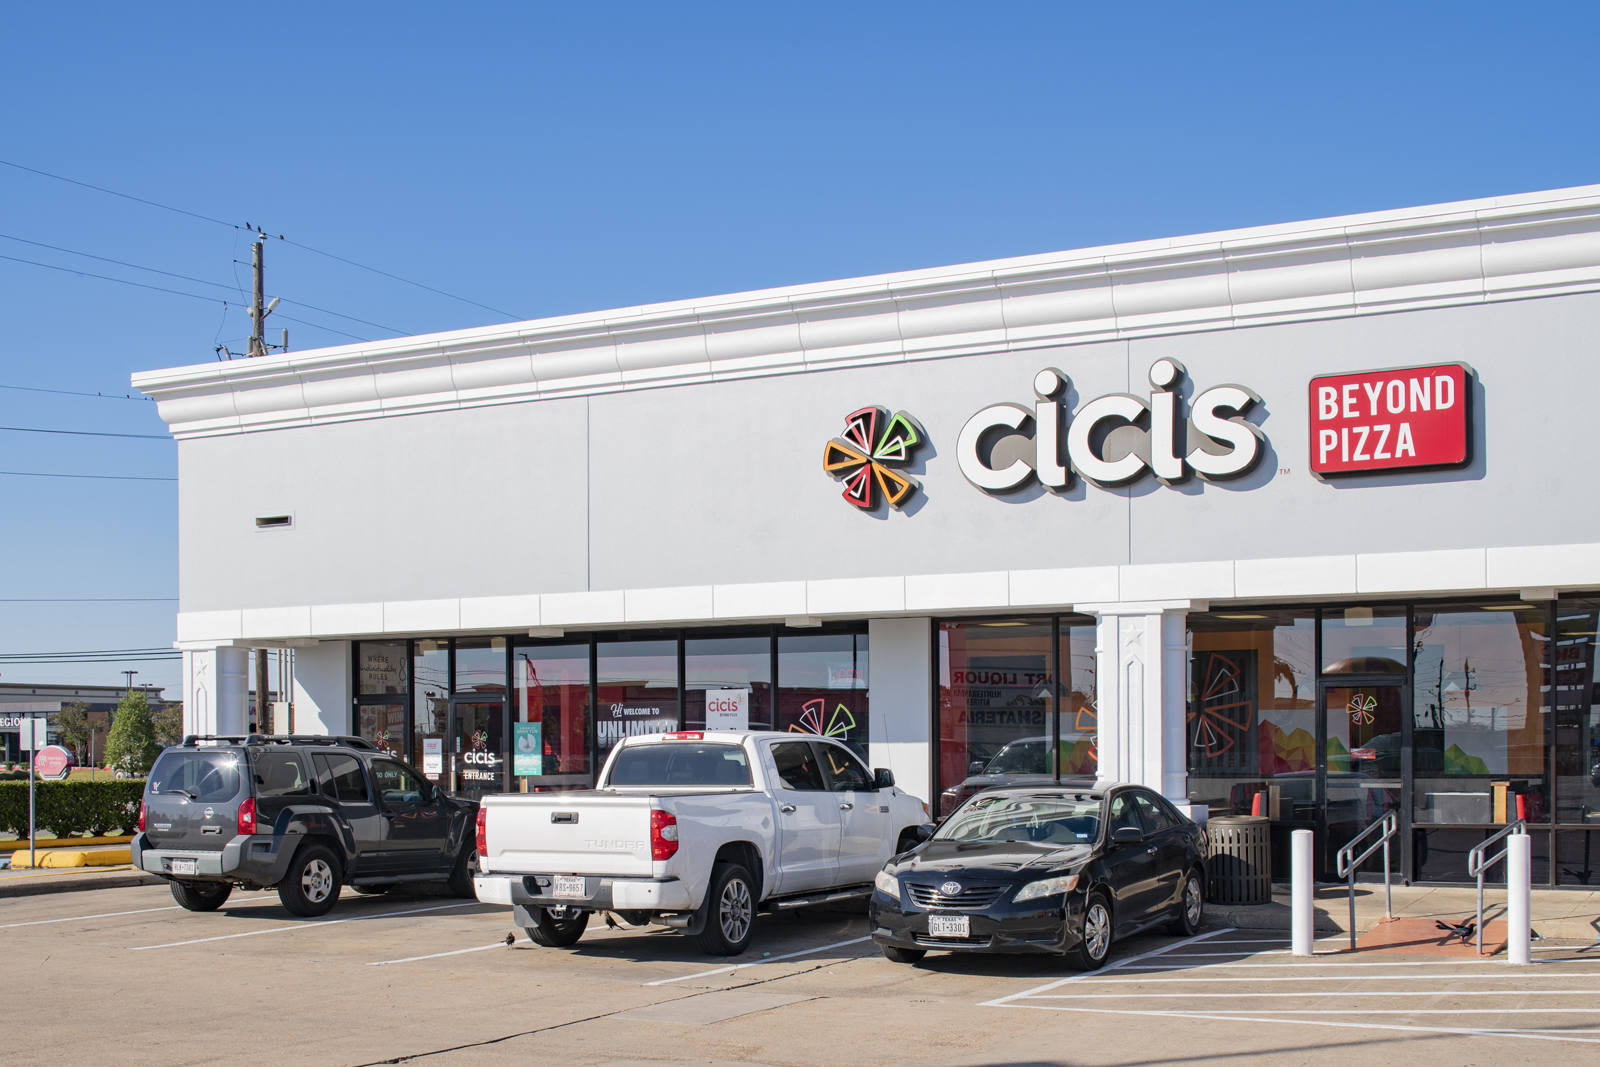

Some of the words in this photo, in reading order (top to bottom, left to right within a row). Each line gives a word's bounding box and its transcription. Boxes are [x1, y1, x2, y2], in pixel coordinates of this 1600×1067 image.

[1317, 375, 1456, 421] BEYOND
[957, 357, 1261, 490] cicis
[1318, 422, 1417, 465] PIZZA
[610, 703, 624, 718] Hi
[624, 707, 651, 716] WELCOME
[652, 707, 660, 715] TO
[708, 698, 738, 712] cicis
[597, 720, 678, 738] UNLIMITED
[463, 748, 496, 764] cicis
[464, 771, 495, 781] ENTRANCE
[584, 839, 646, 850] TUNDRA
